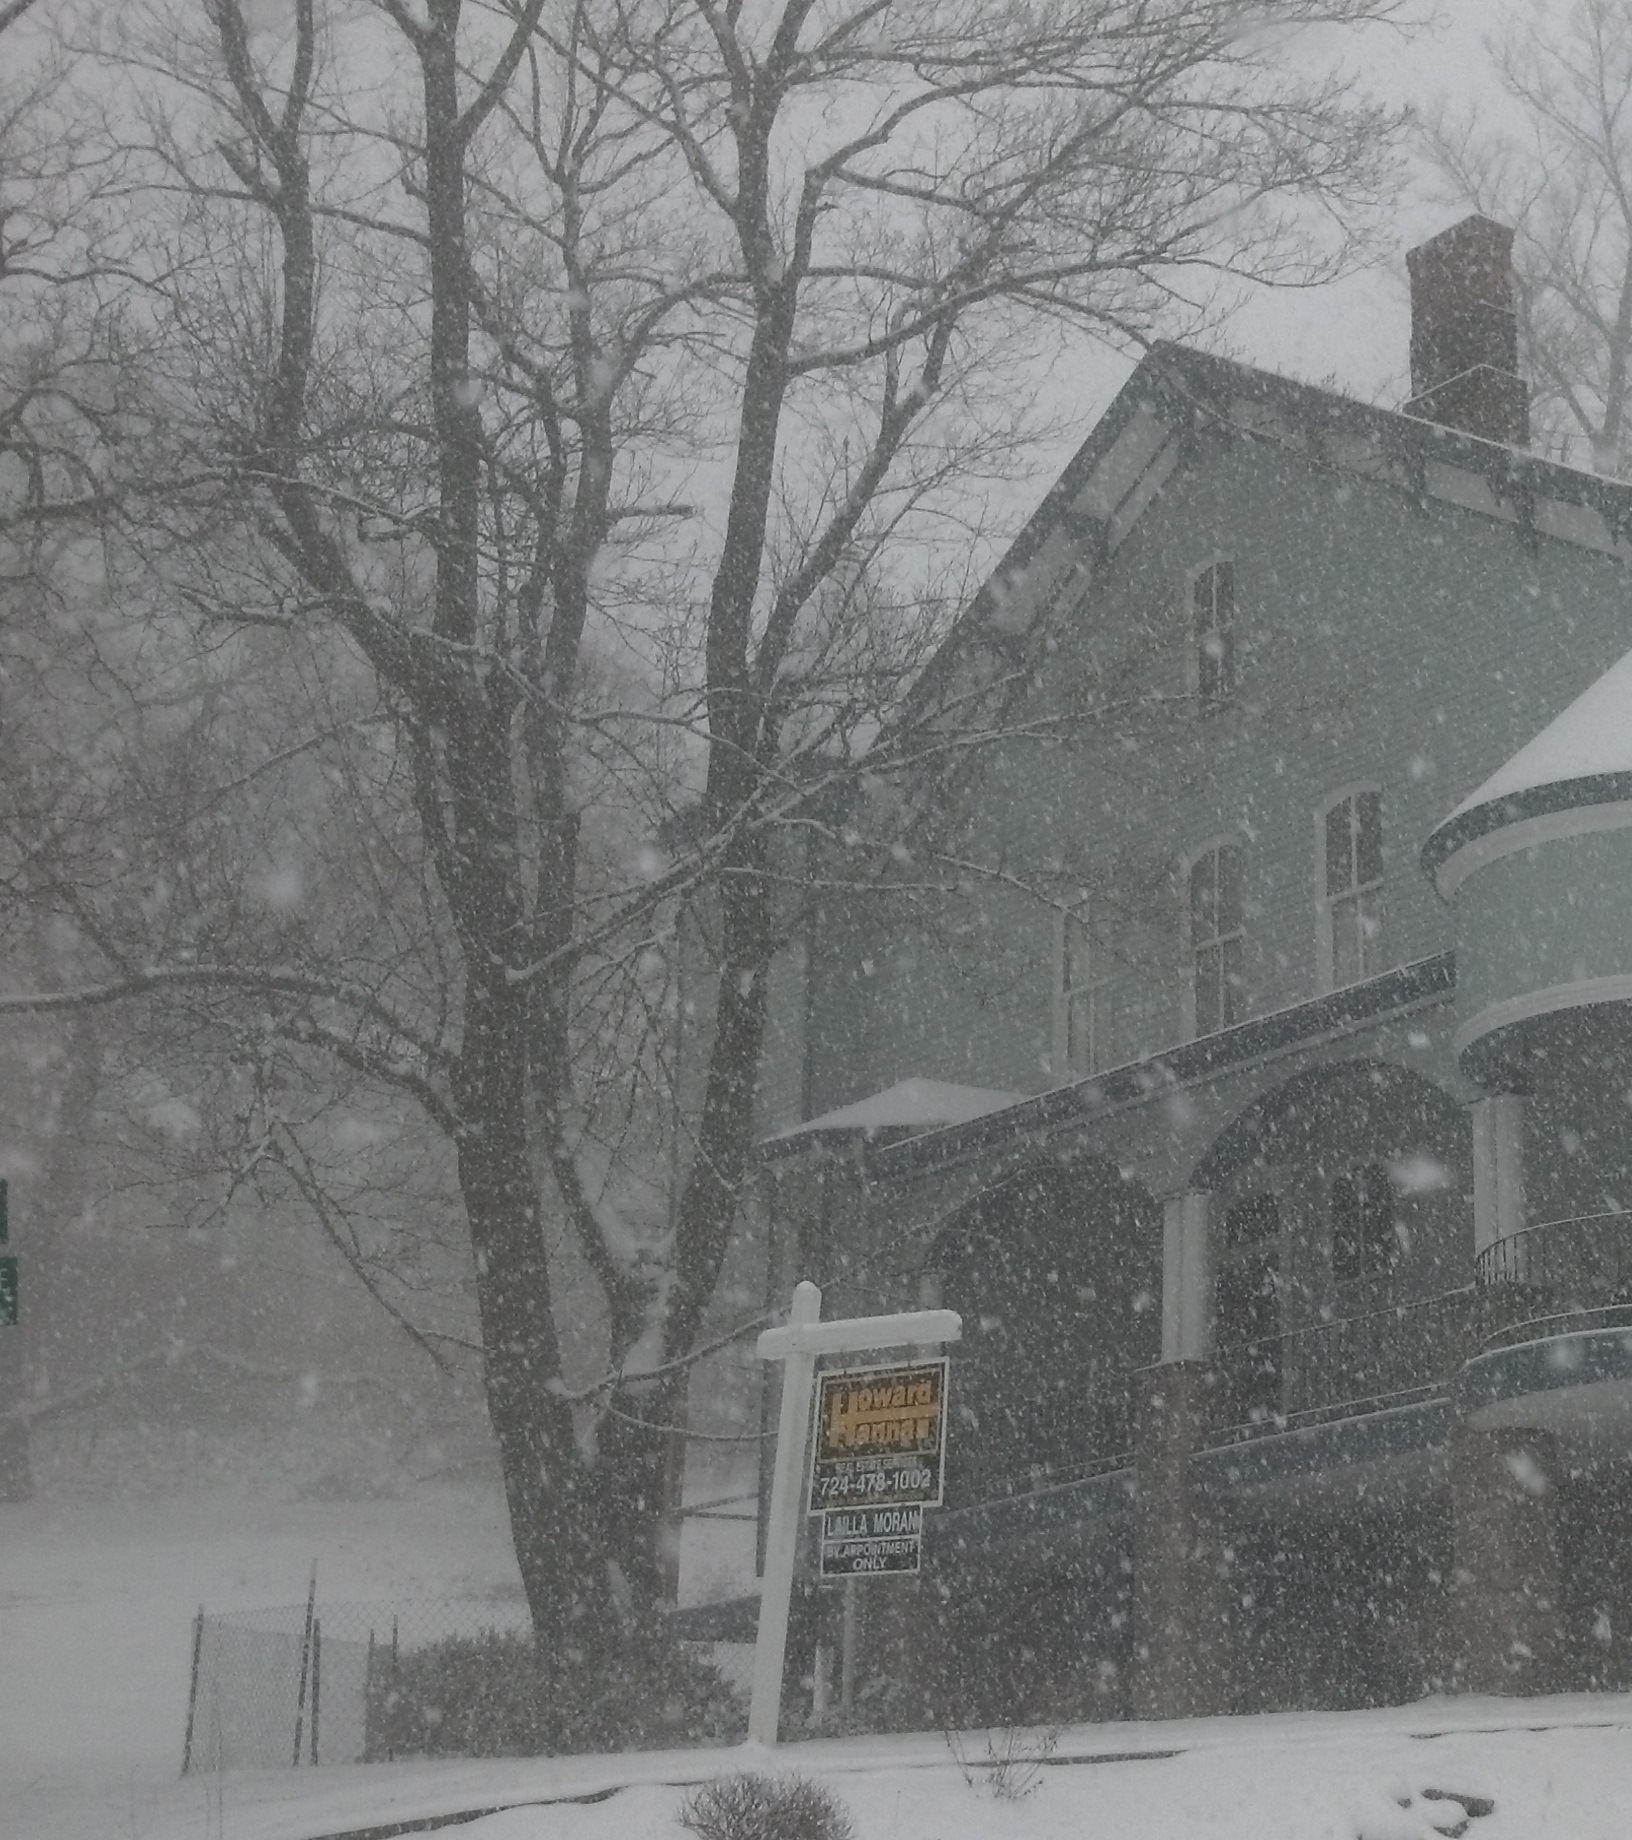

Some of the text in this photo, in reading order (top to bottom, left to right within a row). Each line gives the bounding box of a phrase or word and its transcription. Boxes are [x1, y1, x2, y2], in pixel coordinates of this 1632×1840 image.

[829, 1381, 932, 1417] Howard
[820, 1468, 932, 1496] 724-478-1002
[873, 1510, 920, 1533] MORAN
[827, 1541, 914, 1558] BY APPOINTMENT
[853, 1556, 887, 1570] ONLY
